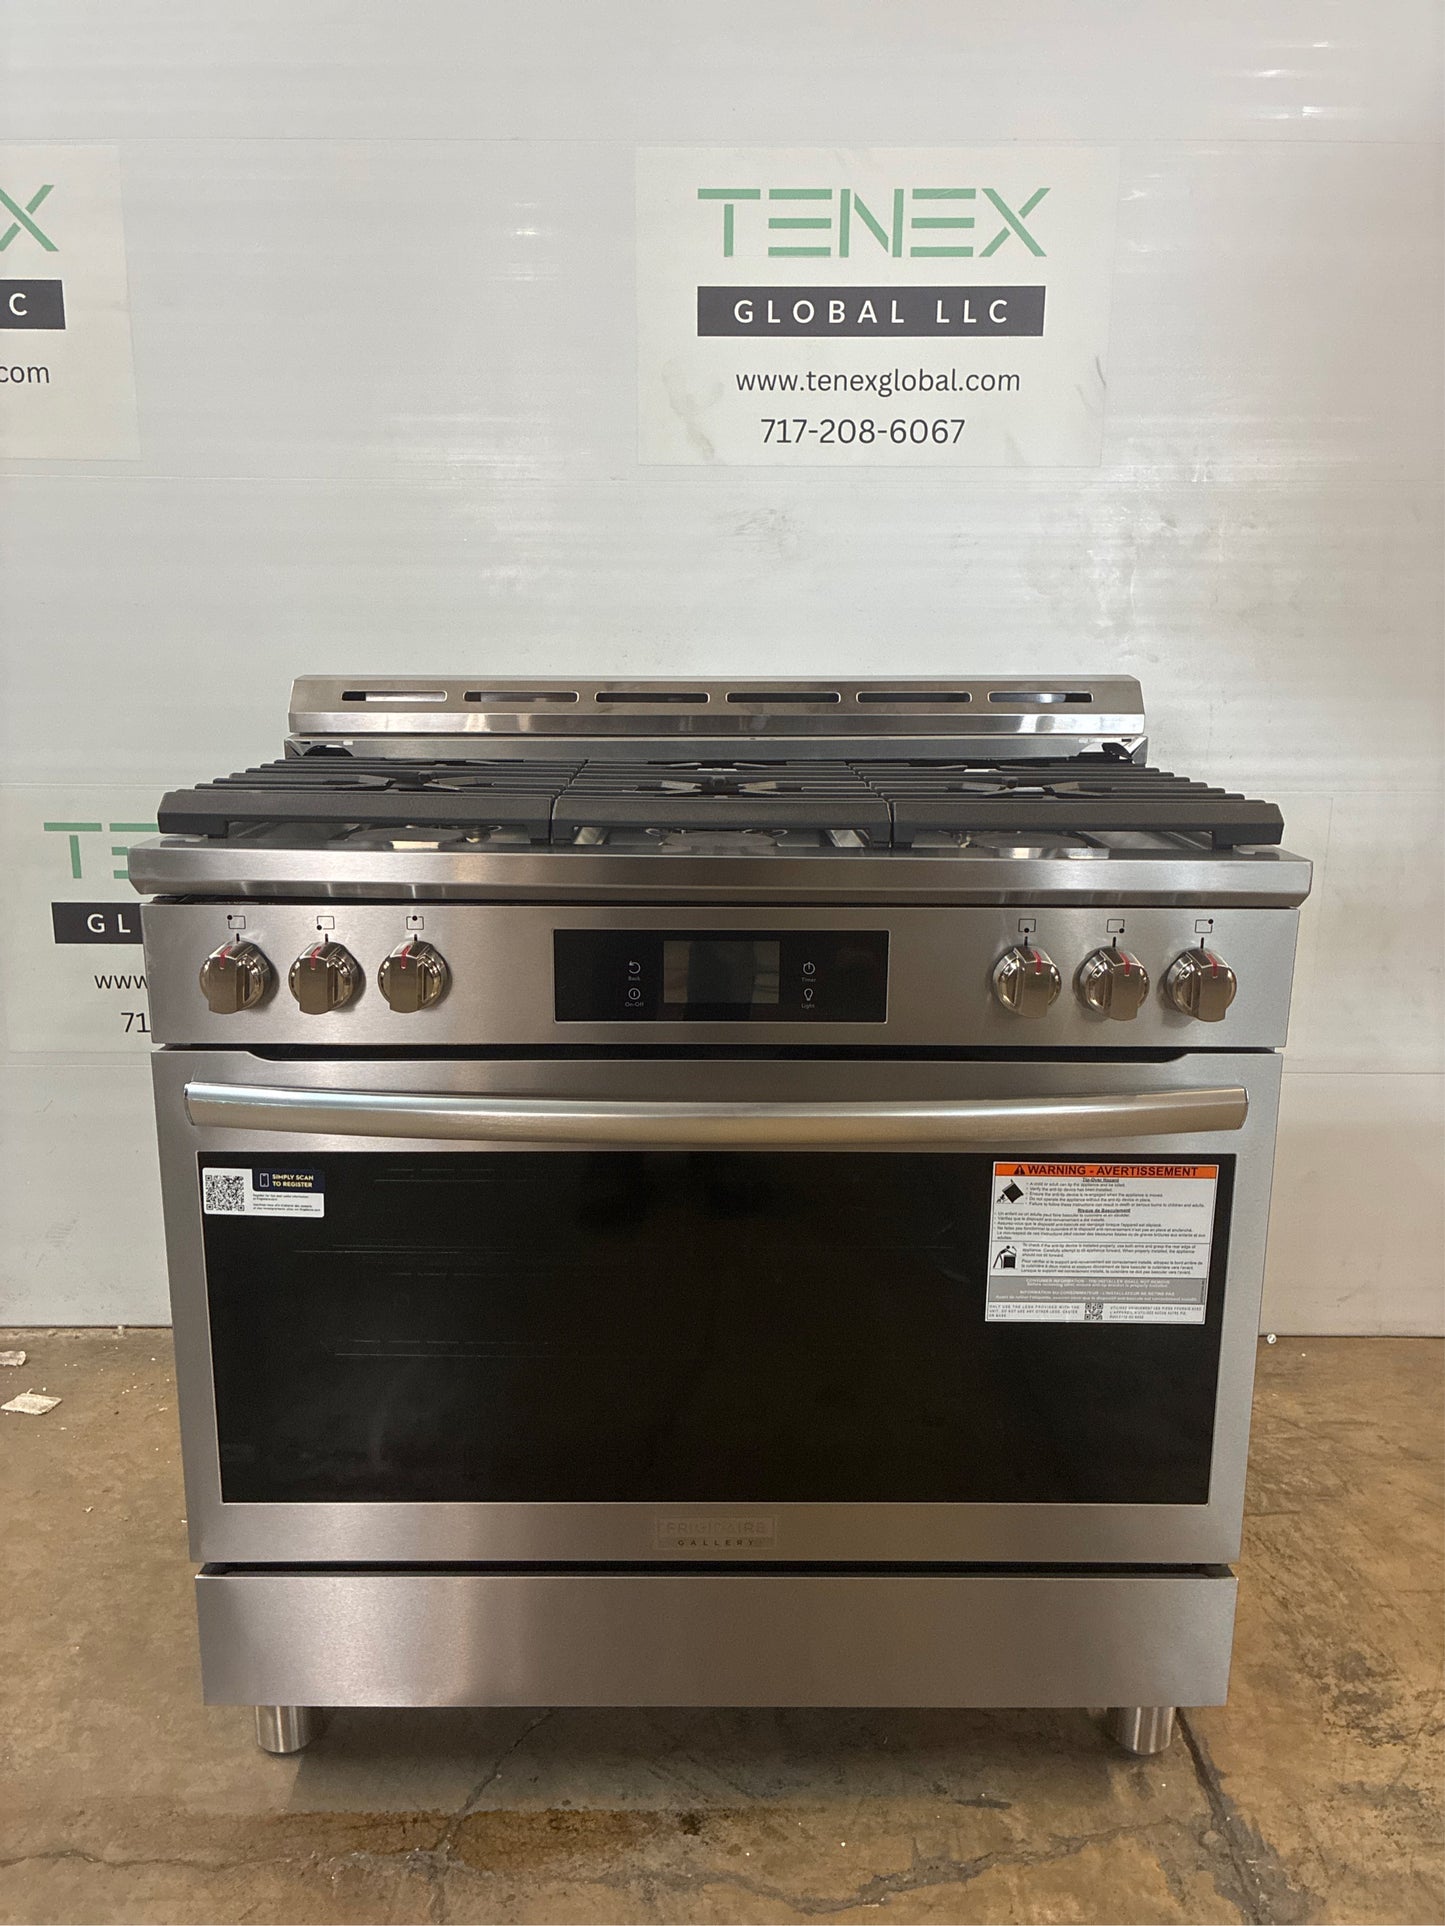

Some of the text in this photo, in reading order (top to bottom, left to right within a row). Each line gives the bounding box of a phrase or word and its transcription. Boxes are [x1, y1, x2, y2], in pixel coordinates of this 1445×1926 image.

[697, 187, 1051, 258] TENEX
[733, 299, 1008, 324] GLOBAL LLC
[735, 368, 1020, 397] www.tenexglobal.com
[761, 418, 965, 443] 717-208-6067
[1028, 1165, 1086, 1175] WARNING
[1096, 1166, 1198, 1176] AVERTISSEMENT
